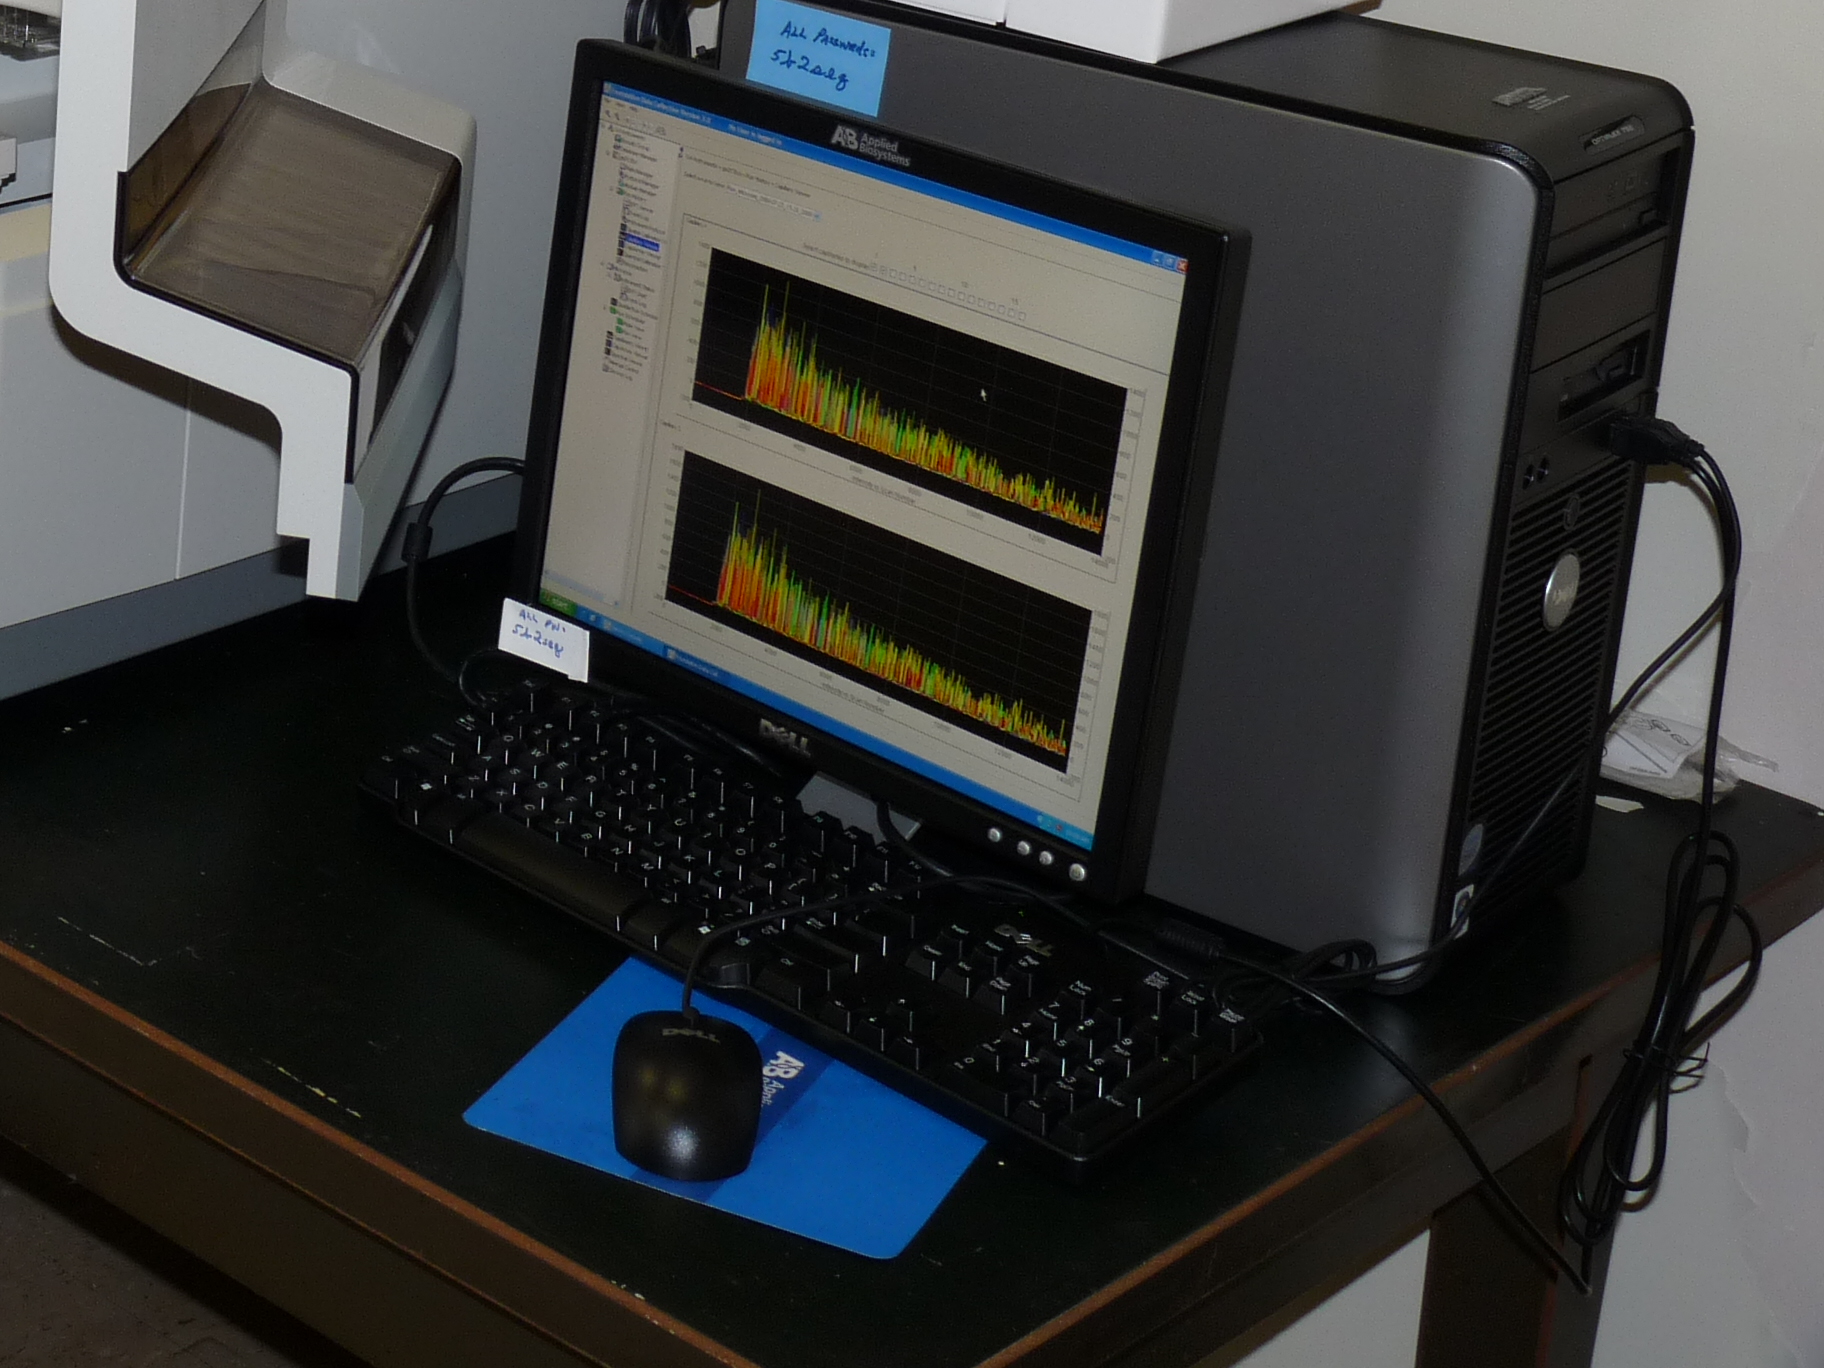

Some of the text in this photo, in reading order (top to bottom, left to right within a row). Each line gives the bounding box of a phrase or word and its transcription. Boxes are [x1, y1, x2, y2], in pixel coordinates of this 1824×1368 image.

[780, 21, 807, 40] ALL
[861, 133, 899, 153] Applied
[859, 144, 911, 167] Biosystems
[519, 609, 538, 623] ALL
